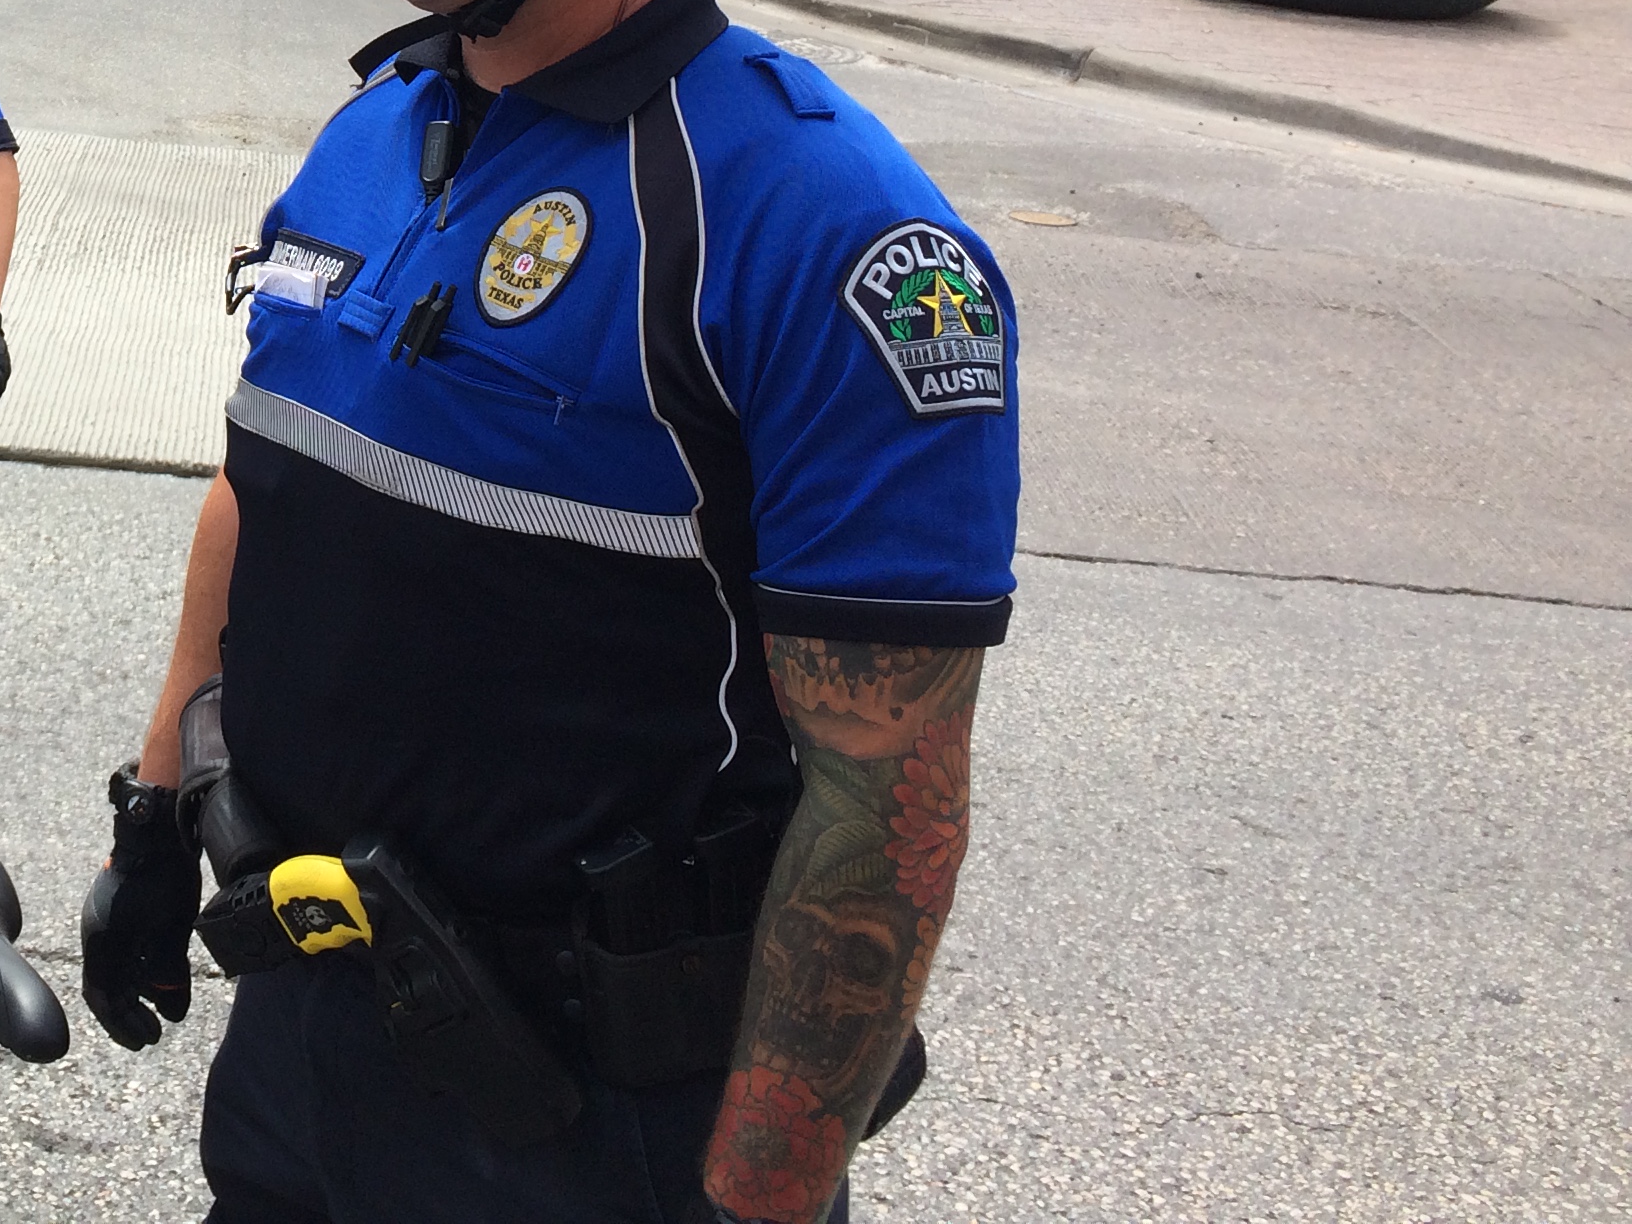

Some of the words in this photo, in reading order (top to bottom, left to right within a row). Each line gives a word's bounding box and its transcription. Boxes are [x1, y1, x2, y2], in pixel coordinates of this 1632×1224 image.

[533, 200, 576, 226] AUSTIN
[313, 254, 345, 282] 6099
[492, 261, 543, 290] POLICE
[861, 235, 984, 301] POLICE
[487, 286, 525, 310] TEXAS
[964, 303, 974, 314] OF
[882, 305, 926, 320] CAPITAL
[920, 368, 1000, 398] AUSTIN
